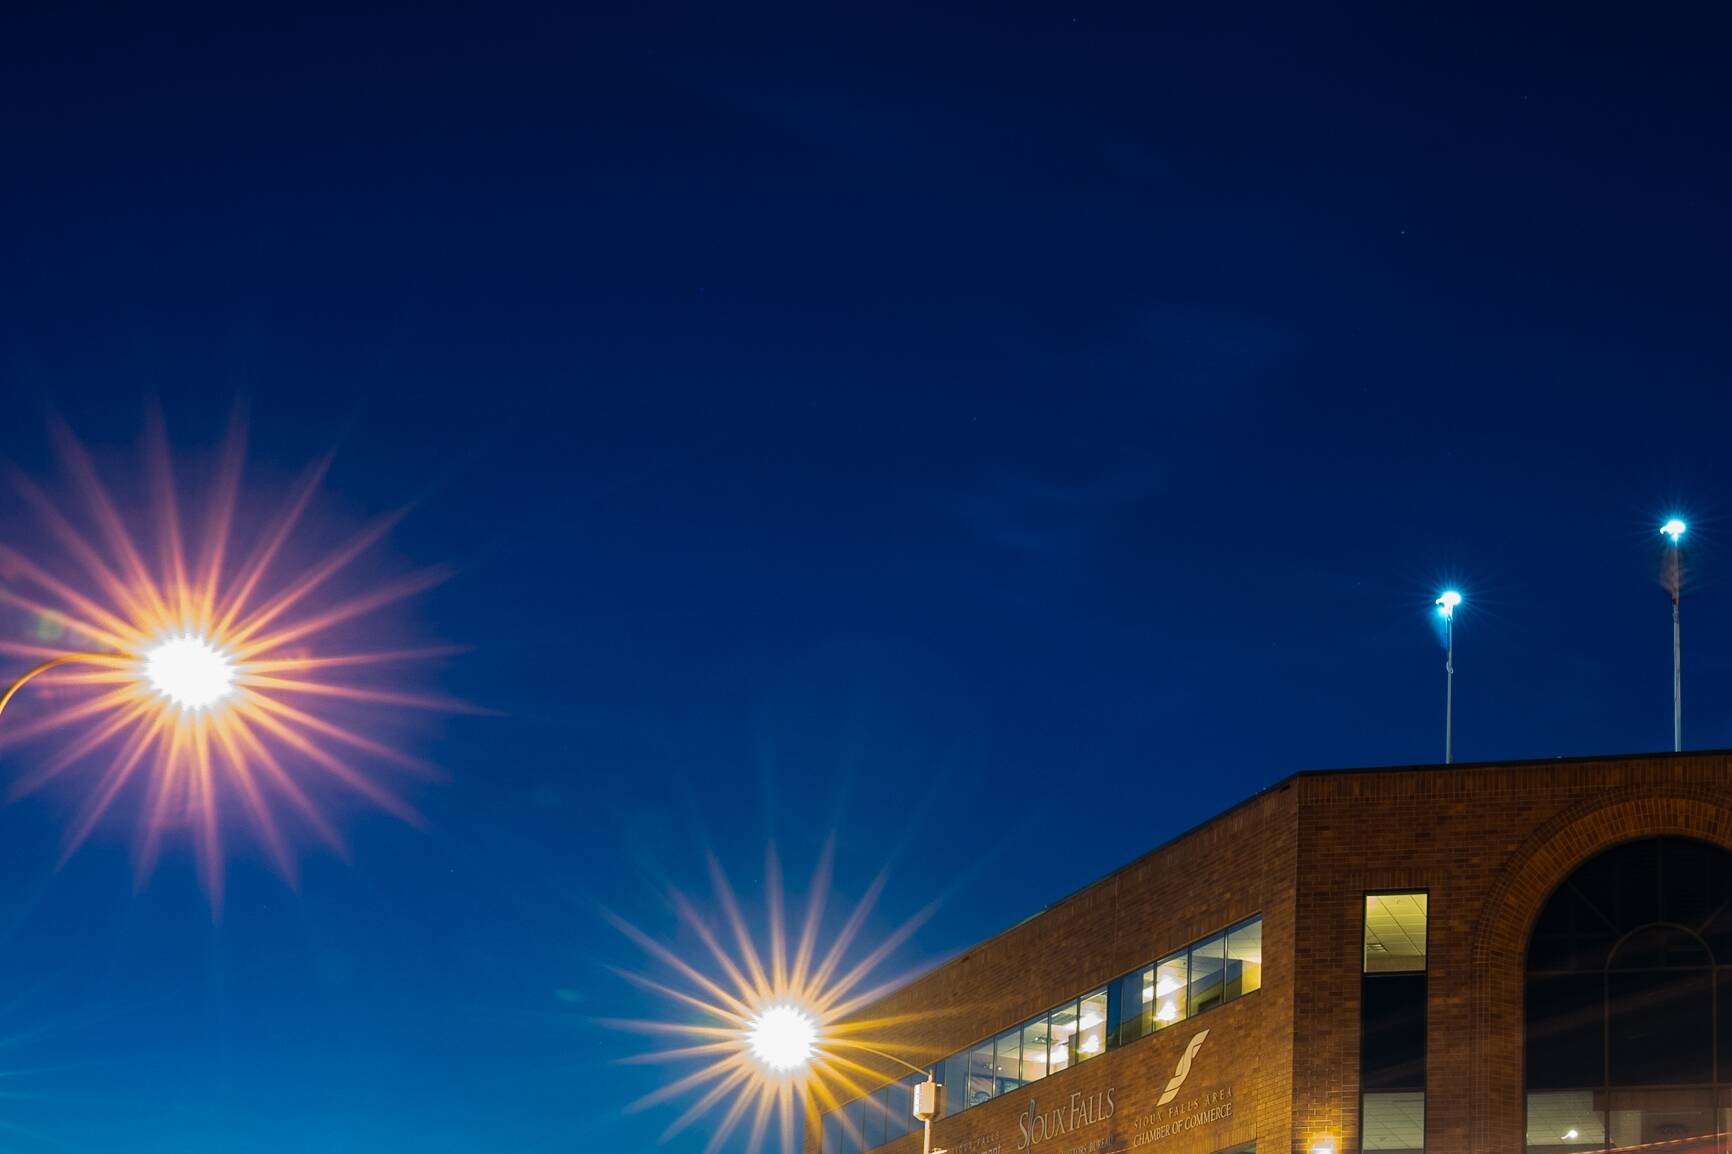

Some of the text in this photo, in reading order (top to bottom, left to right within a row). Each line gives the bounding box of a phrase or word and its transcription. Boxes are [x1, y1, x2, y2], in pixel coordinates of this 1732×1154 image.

[1068, 1087, 1115, 1132] FALLS
[1133, 1102, 1233, 1148] CHAMBER OF COMMERCE
[1134, 1087, 1233, 1129] SIOUX FALLS AREA
